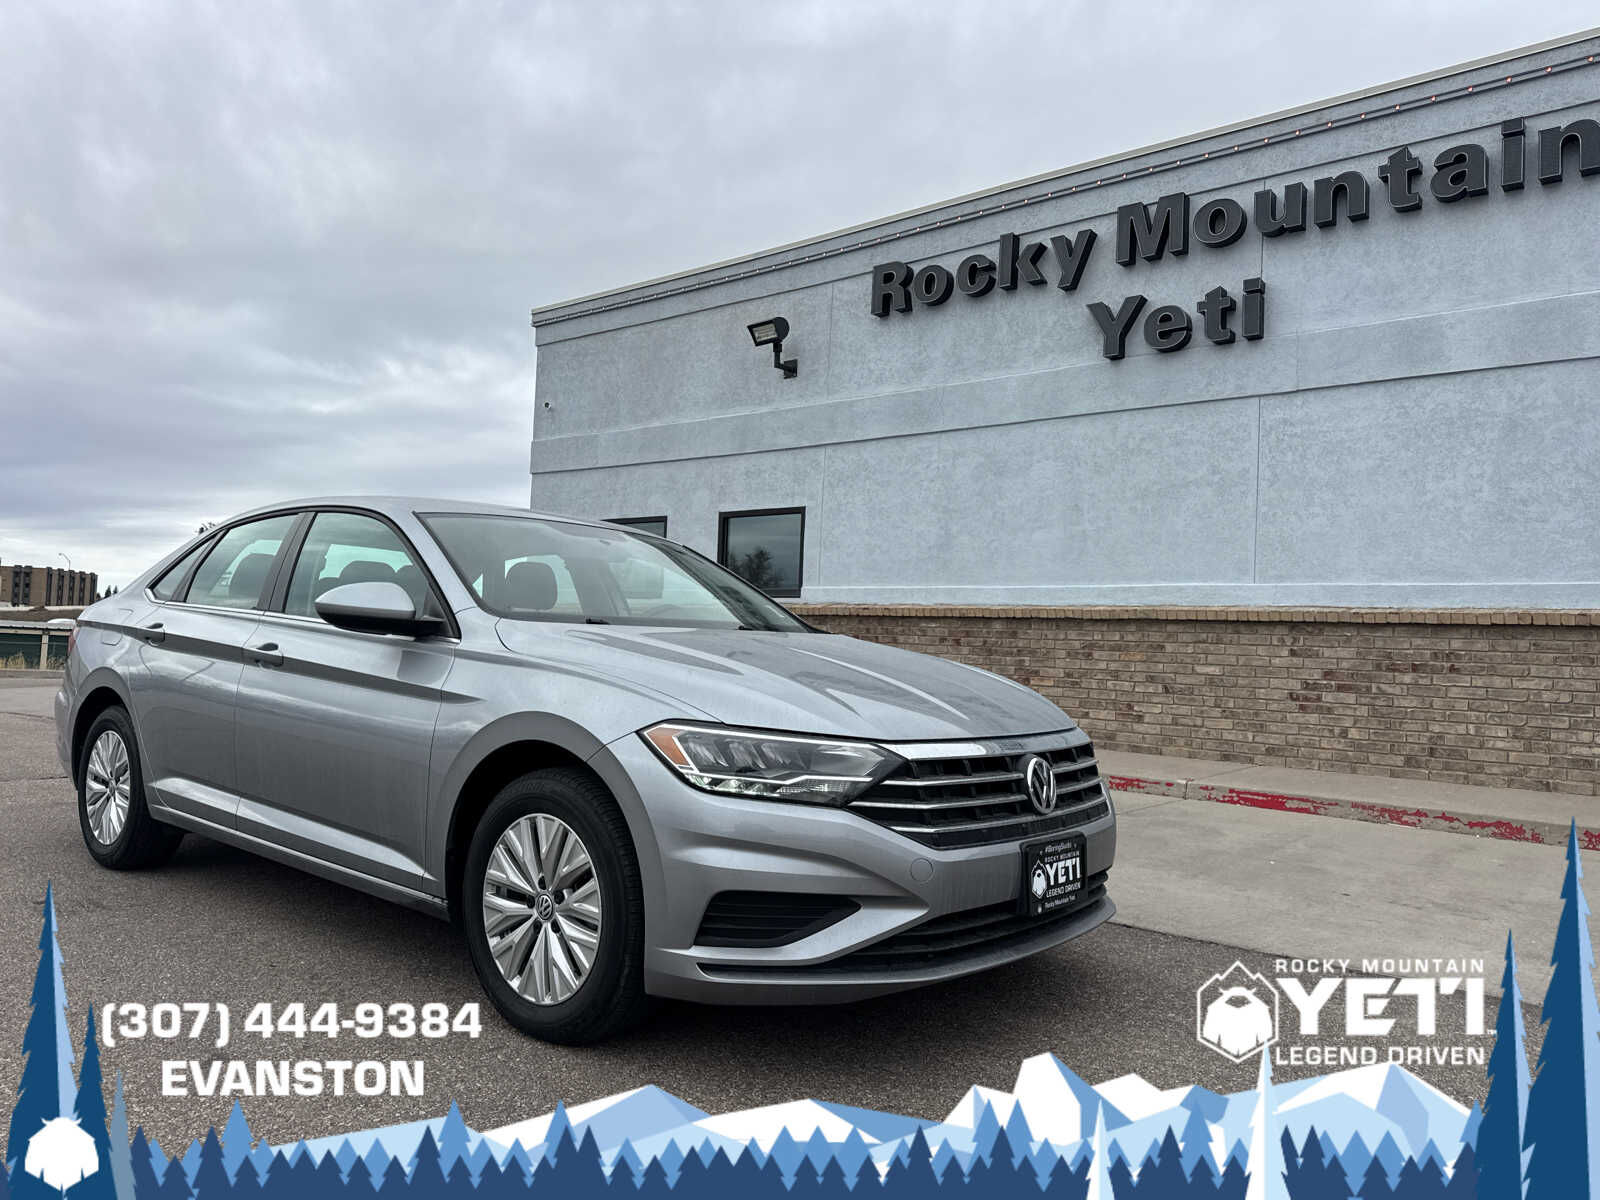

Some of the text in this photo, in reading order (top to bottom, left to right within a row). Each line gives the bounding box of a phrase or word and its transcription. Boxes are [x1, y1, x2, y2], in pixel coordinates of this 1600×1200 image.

[871, 116, 1600, 318] Rocky Mountain
[1086, 277, 1266, 360] Yeti
[1045, 857, 1080, 886] YETI
[1046, 881, 1081, 898] LEGEND DRIVEN
